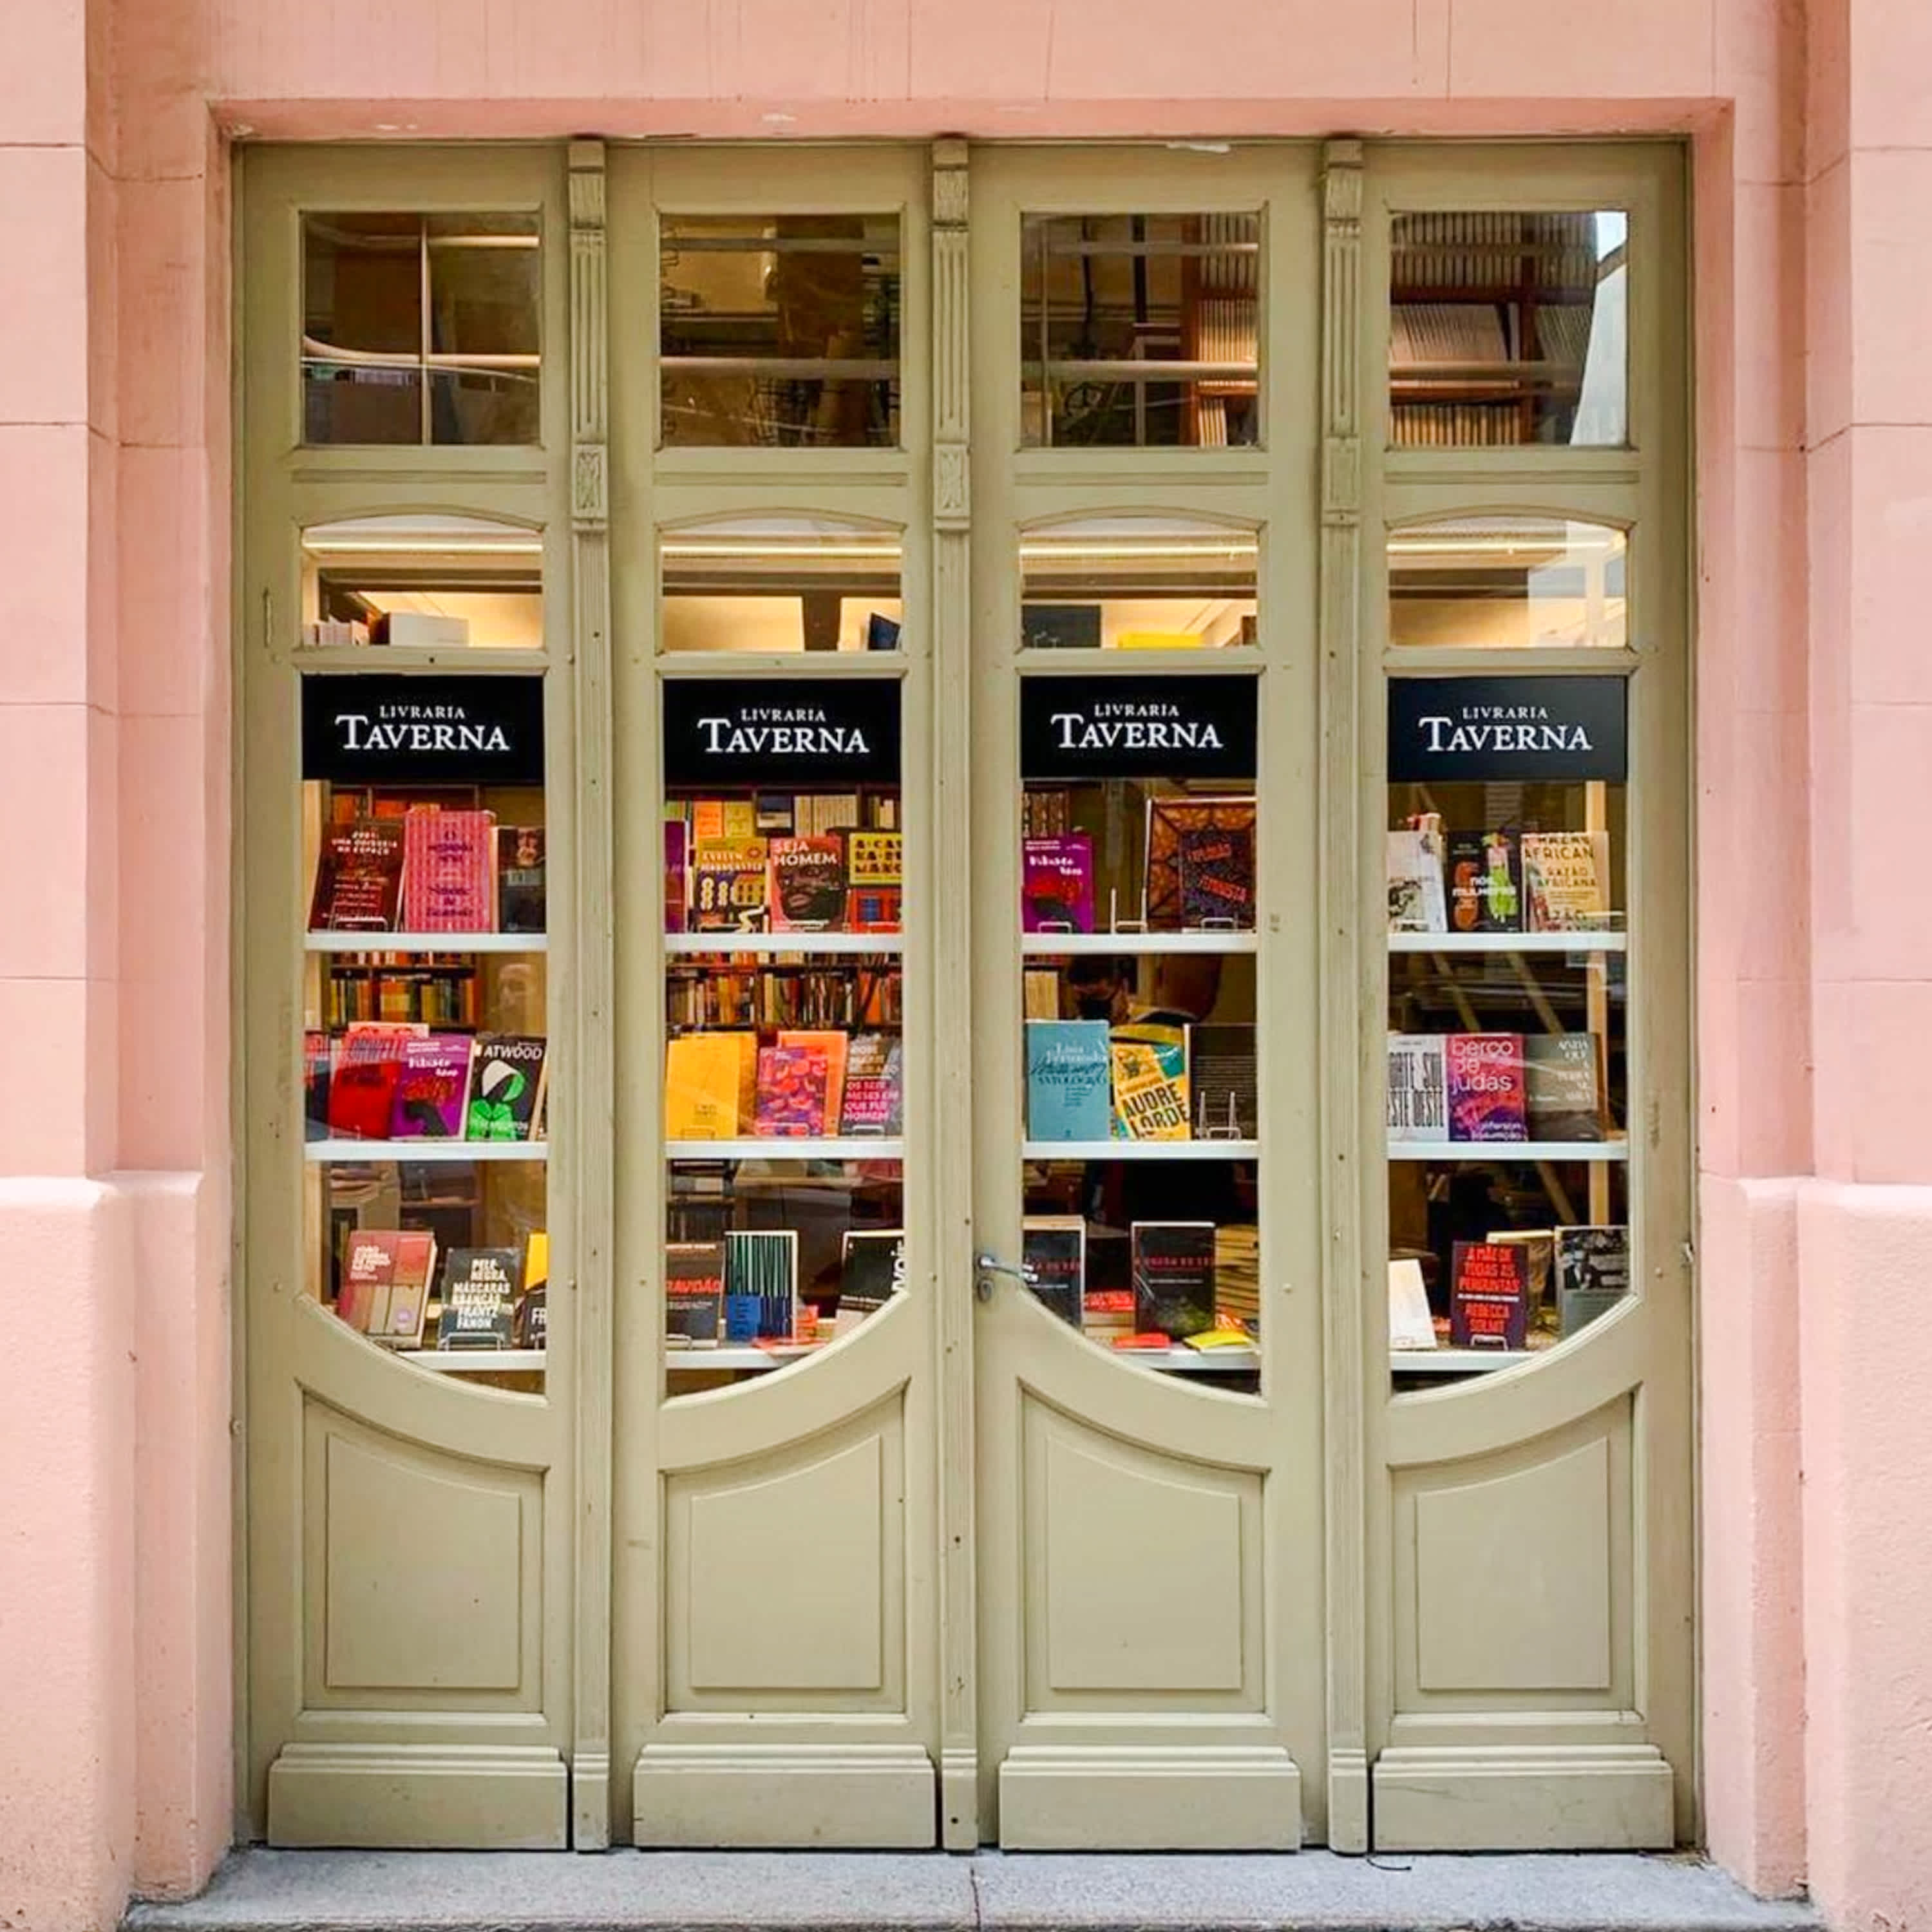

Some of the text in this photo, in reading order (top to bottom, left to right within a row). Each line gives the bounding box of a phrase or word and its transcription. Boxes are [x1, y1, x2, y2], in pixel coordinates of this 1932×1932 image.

[380, 706, 465, 719] LIVRARIA
[741, 708, 826, 722] LIVRARIA
[1095, 704, 1180, 717] LIVRARIA
[1463, 707, 1548, 719] LIVRARIA
[773, 840, 810, 854] SEJA
[773, 852, 837, 866] HOMEM
[484, 1045, 543, 1060] ATWOOD
[1122, 1082, 1182, 1117] AUDRE
